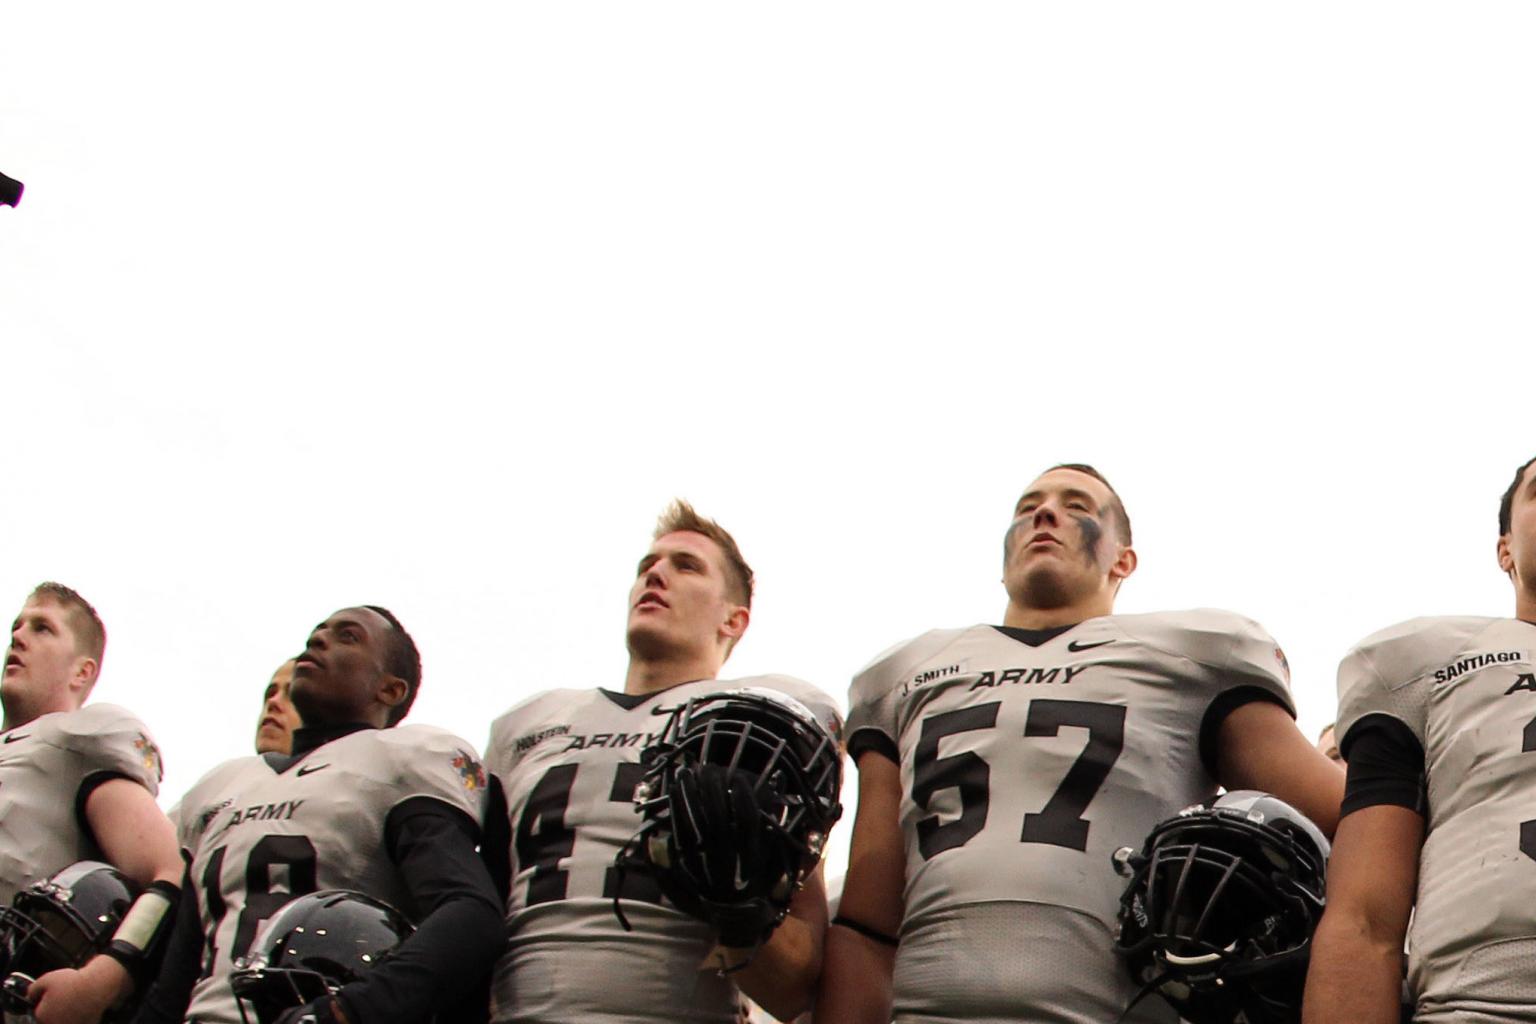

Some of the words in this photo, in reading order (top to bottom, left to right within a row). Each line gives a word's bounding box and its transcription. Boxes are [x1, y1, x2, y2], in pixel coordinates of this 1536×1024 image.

[914, 665, 960, 687] SMITH
[968, 667, 1086, 692] ARMY
[1434, 651, 1521, 684] SANTIAGO
[561, 733, 663, 752] ARMY
[911, 698, 1128, 862] 57
[224, 799, 304, 831] ARMY
